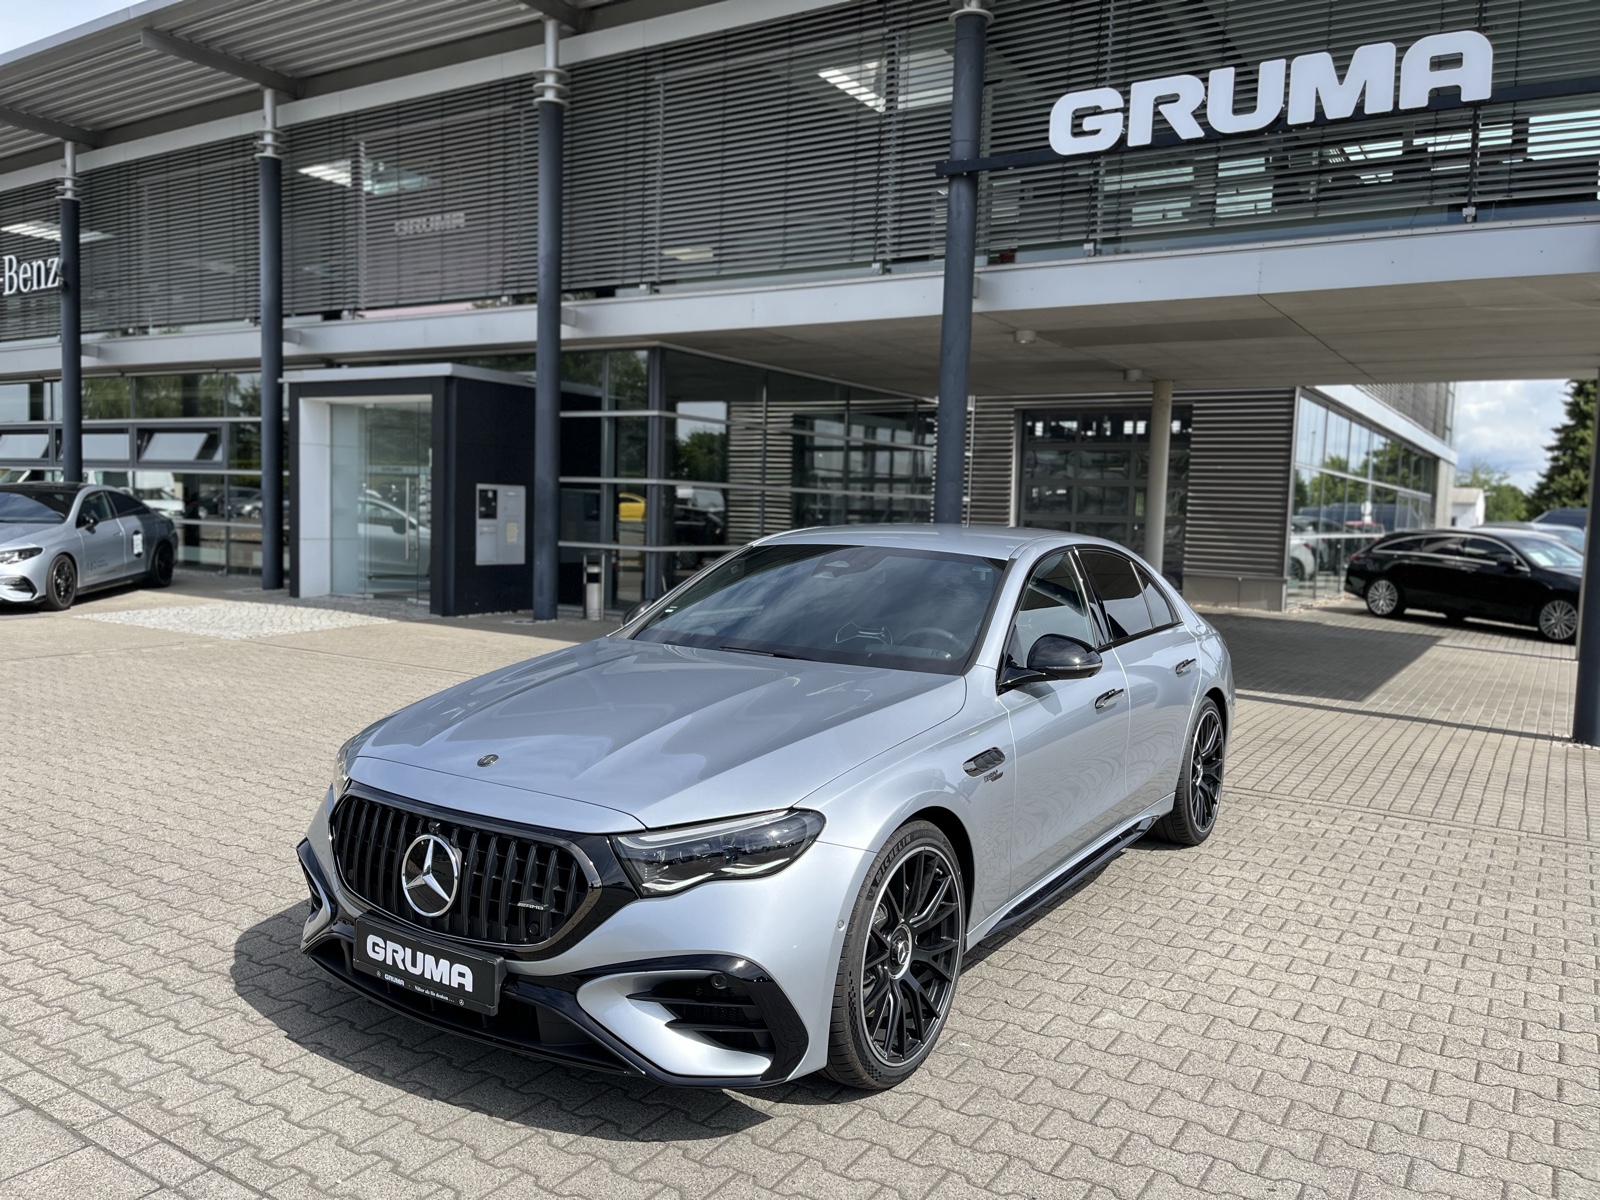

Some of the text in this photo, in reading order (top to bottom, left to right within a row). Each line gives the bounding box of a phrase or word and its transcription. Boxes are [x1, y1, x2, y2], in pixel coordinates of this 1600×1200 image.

[1048, 30, 1494, 156] GRUMA
[875, 834, 912, 884] MICHELIN
[366, 934, 474, 993] GRUMA
[384, 973, 405, 987] GRUMA
